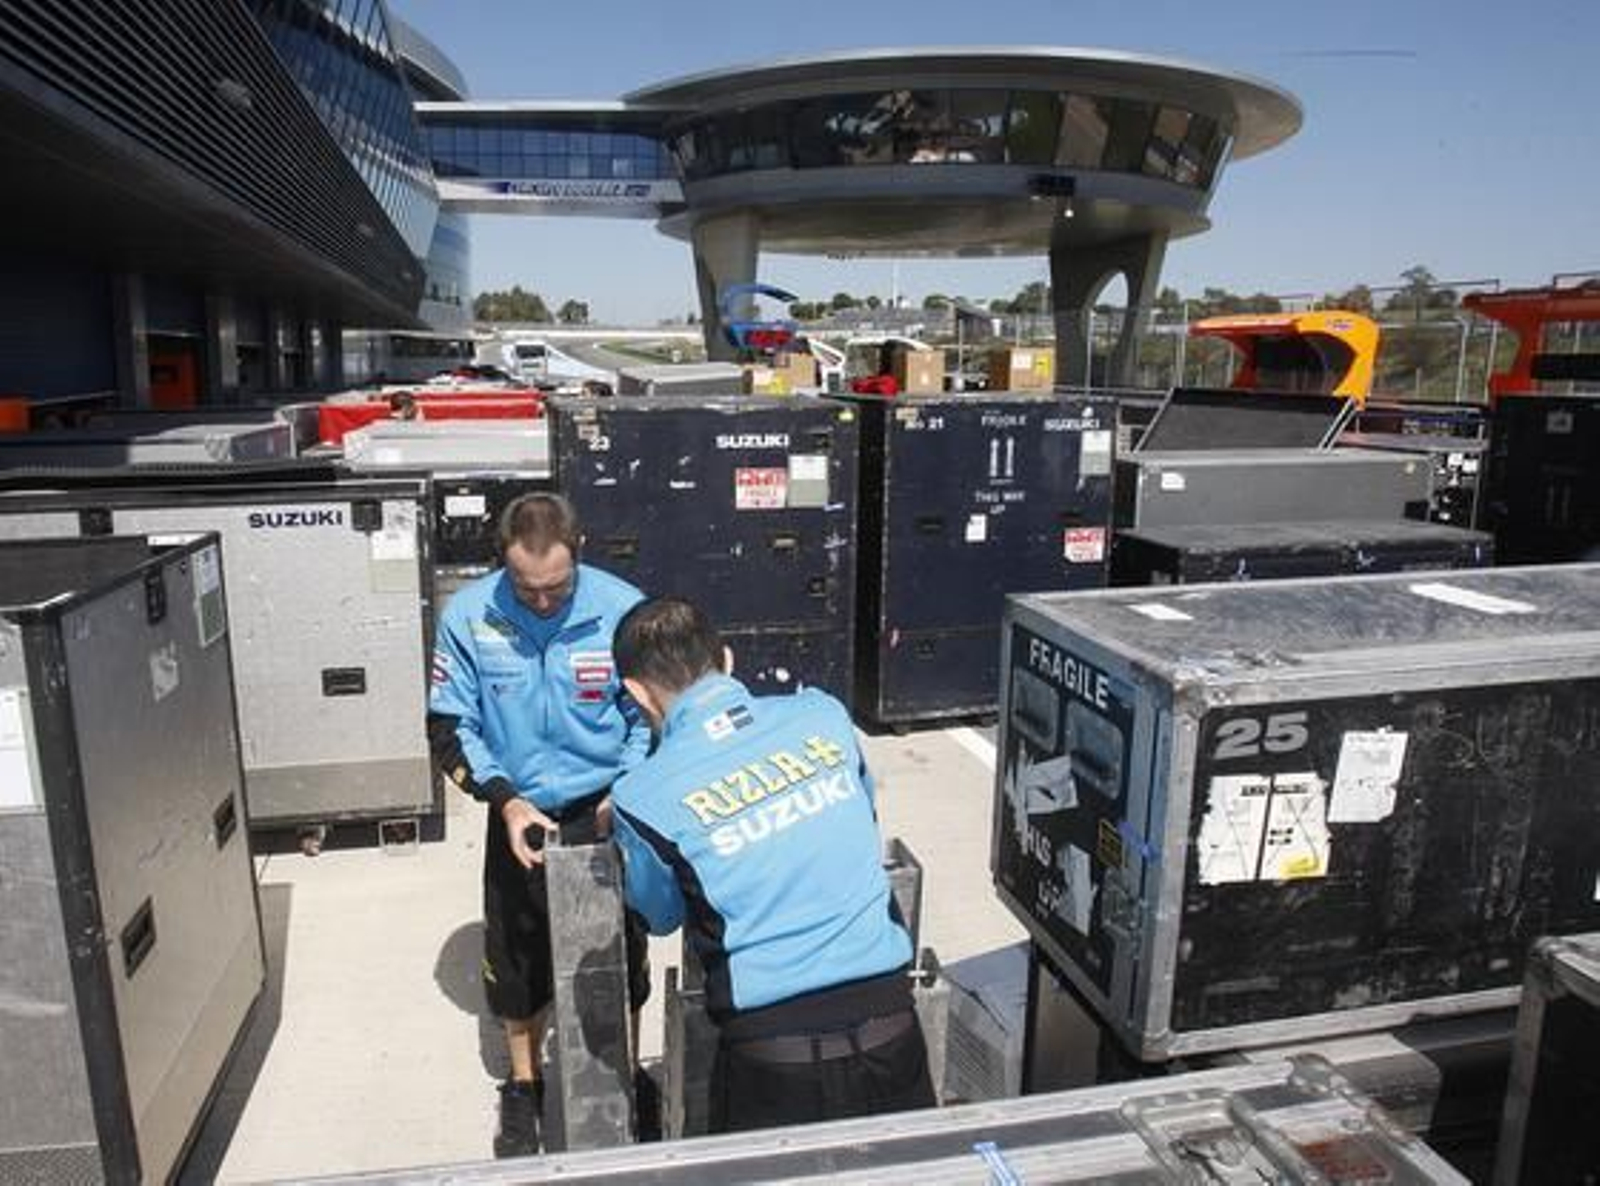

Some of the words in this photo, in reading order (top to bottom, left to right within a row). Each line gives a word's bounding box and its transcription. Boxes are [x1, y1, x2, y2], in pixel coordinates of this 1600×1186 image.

[590, 436, 611, 450] 23
[716, 434, 789, 449] SUZUKI
[248, 510, 343, 529] SUZUKI
[1029, 637, 1110, 710] FRAGILE
[1213, 711, 1309, 760] 25
[710, 771, 857, 856] SUZUKI
